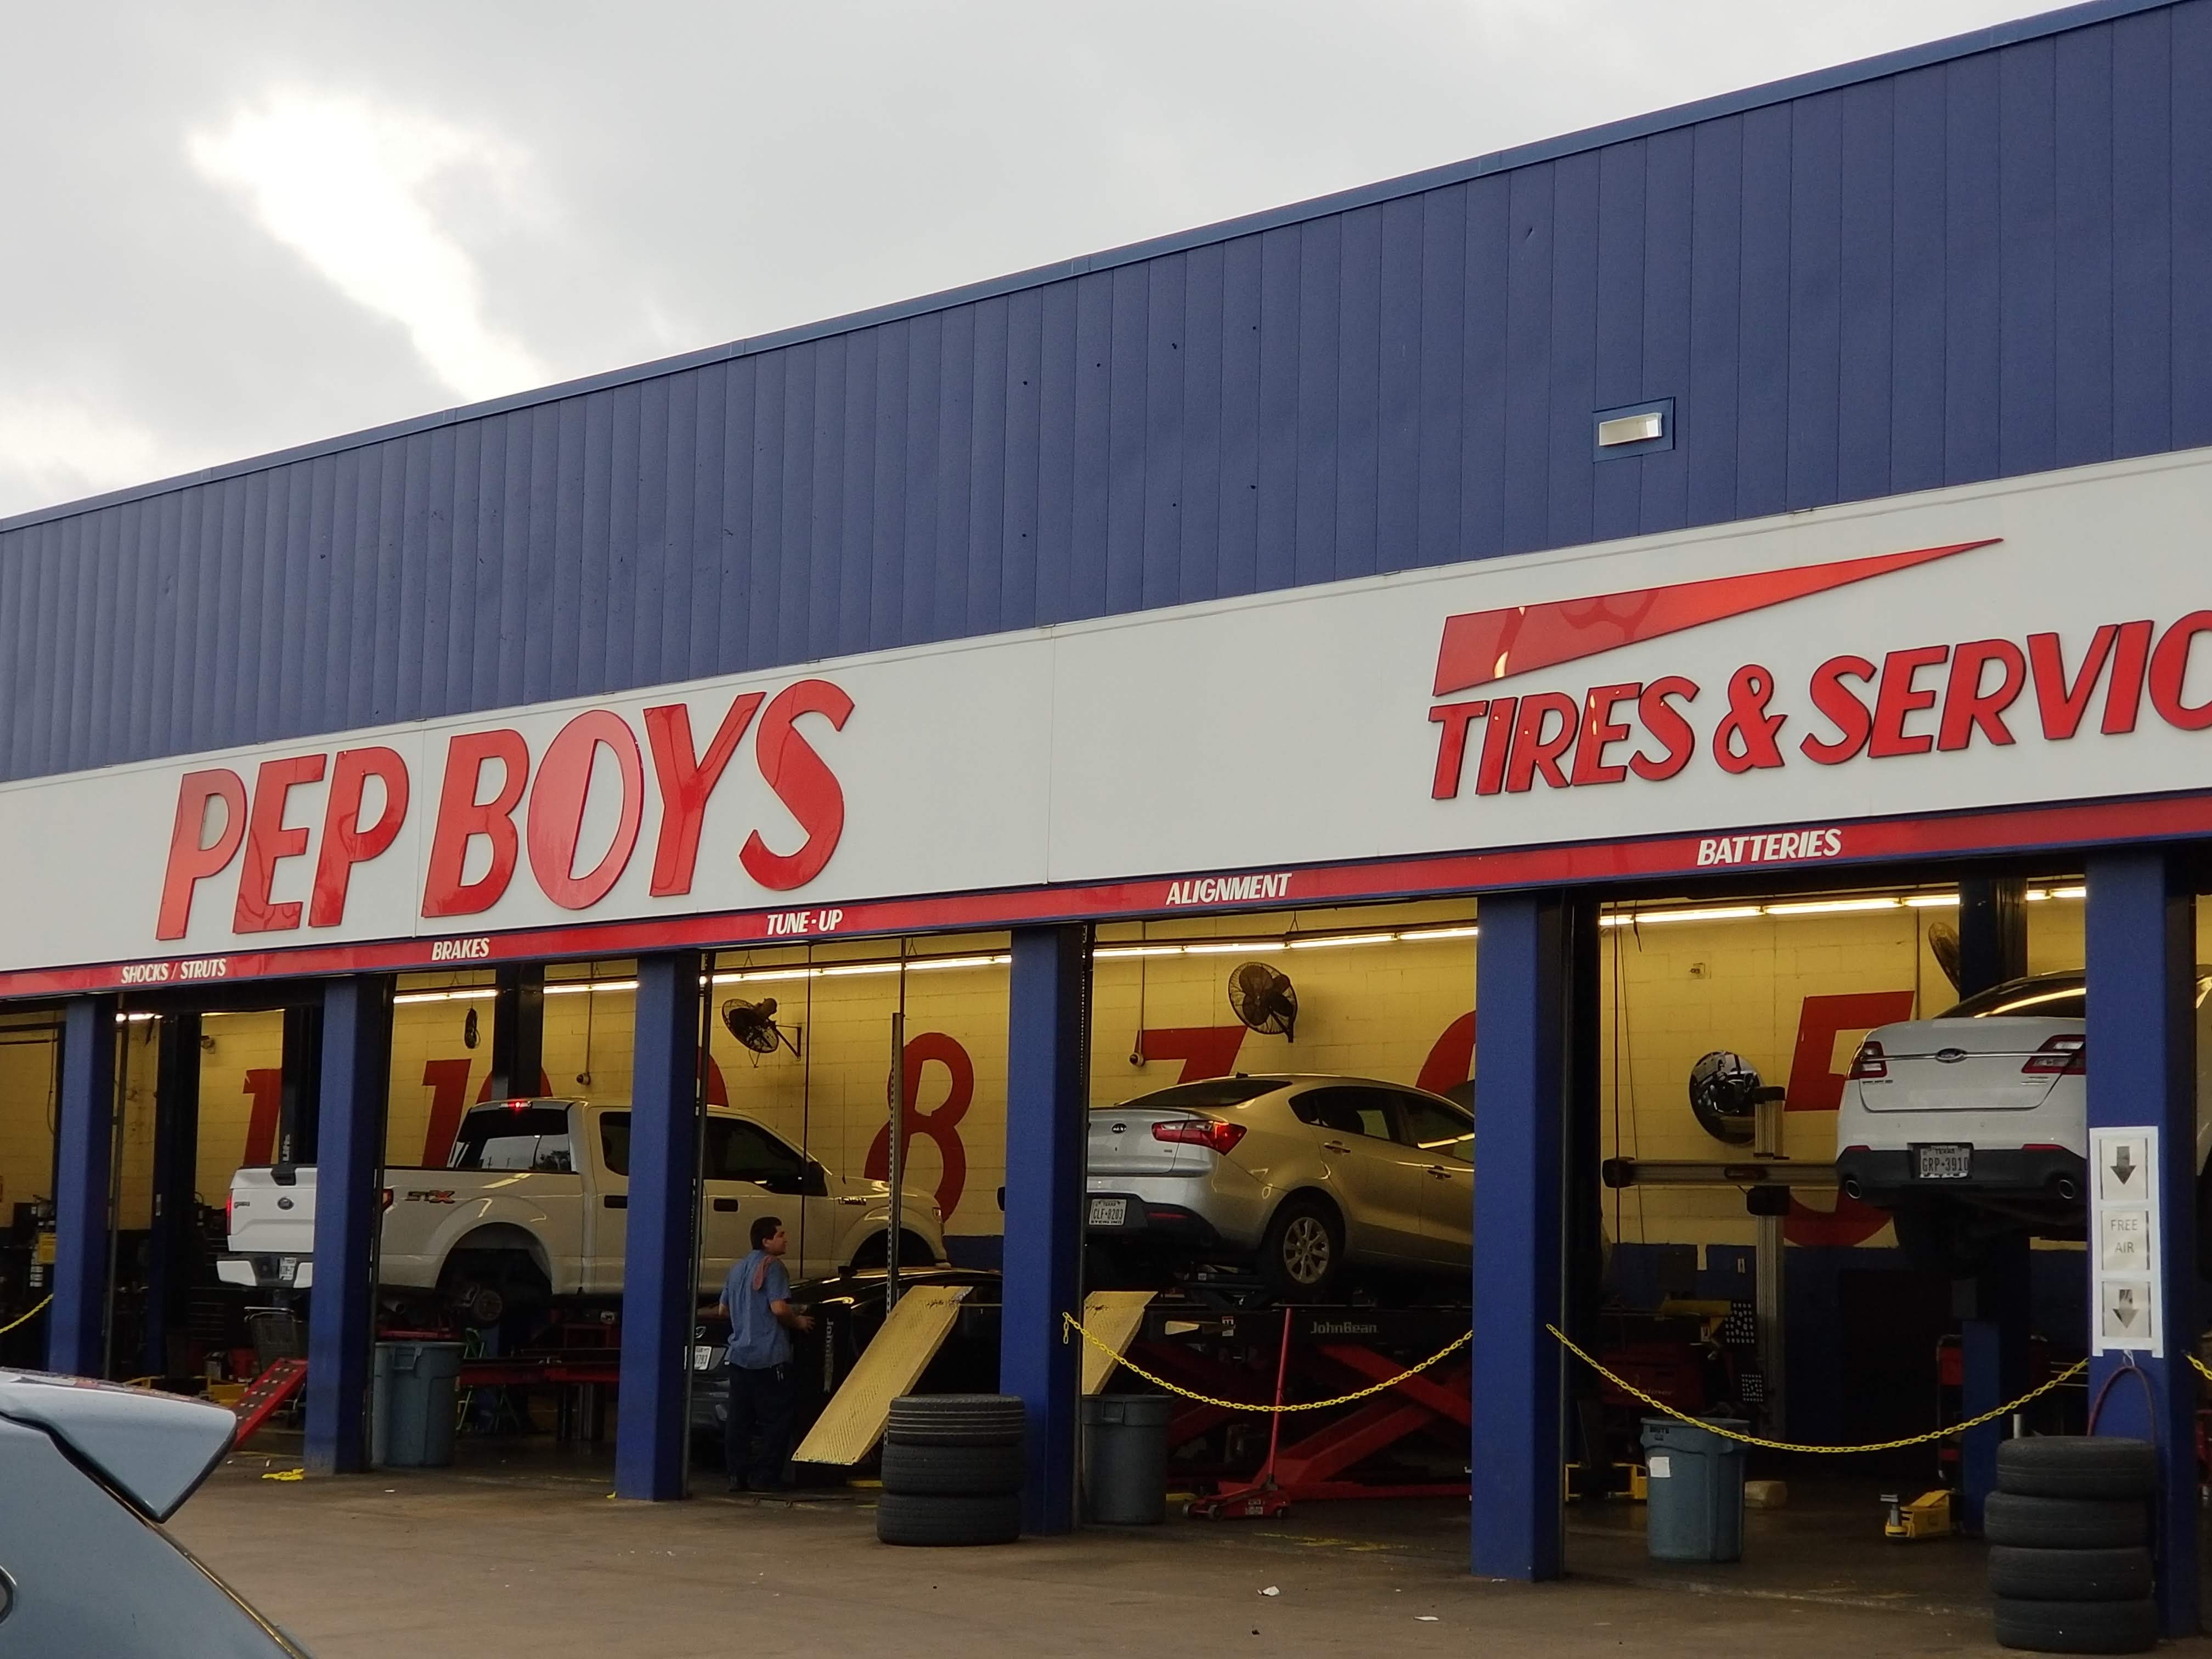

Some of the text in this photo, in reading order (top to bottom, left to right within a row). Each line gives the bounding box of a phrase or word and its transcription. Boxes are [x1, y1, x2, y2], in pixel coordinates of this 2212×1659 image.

[1428, 675, 1701, 799] TIRES
[1713, 663, 1788, 775] &
[155, 679, 856, 941] PEP BOYS
[1696, 828, 1842, 866] BATTERIES
[1165, 873, 1293, 905] ALIGNMENT
[431, 937, 490, 961] BRAKES
[121, 963, 169, 984] SHOCKS
[180, 958, 227, 980] STRUTS
[2111, 1219, 2138, 1231] FREE
[2115, 1242, 2135, 1253] AIR
